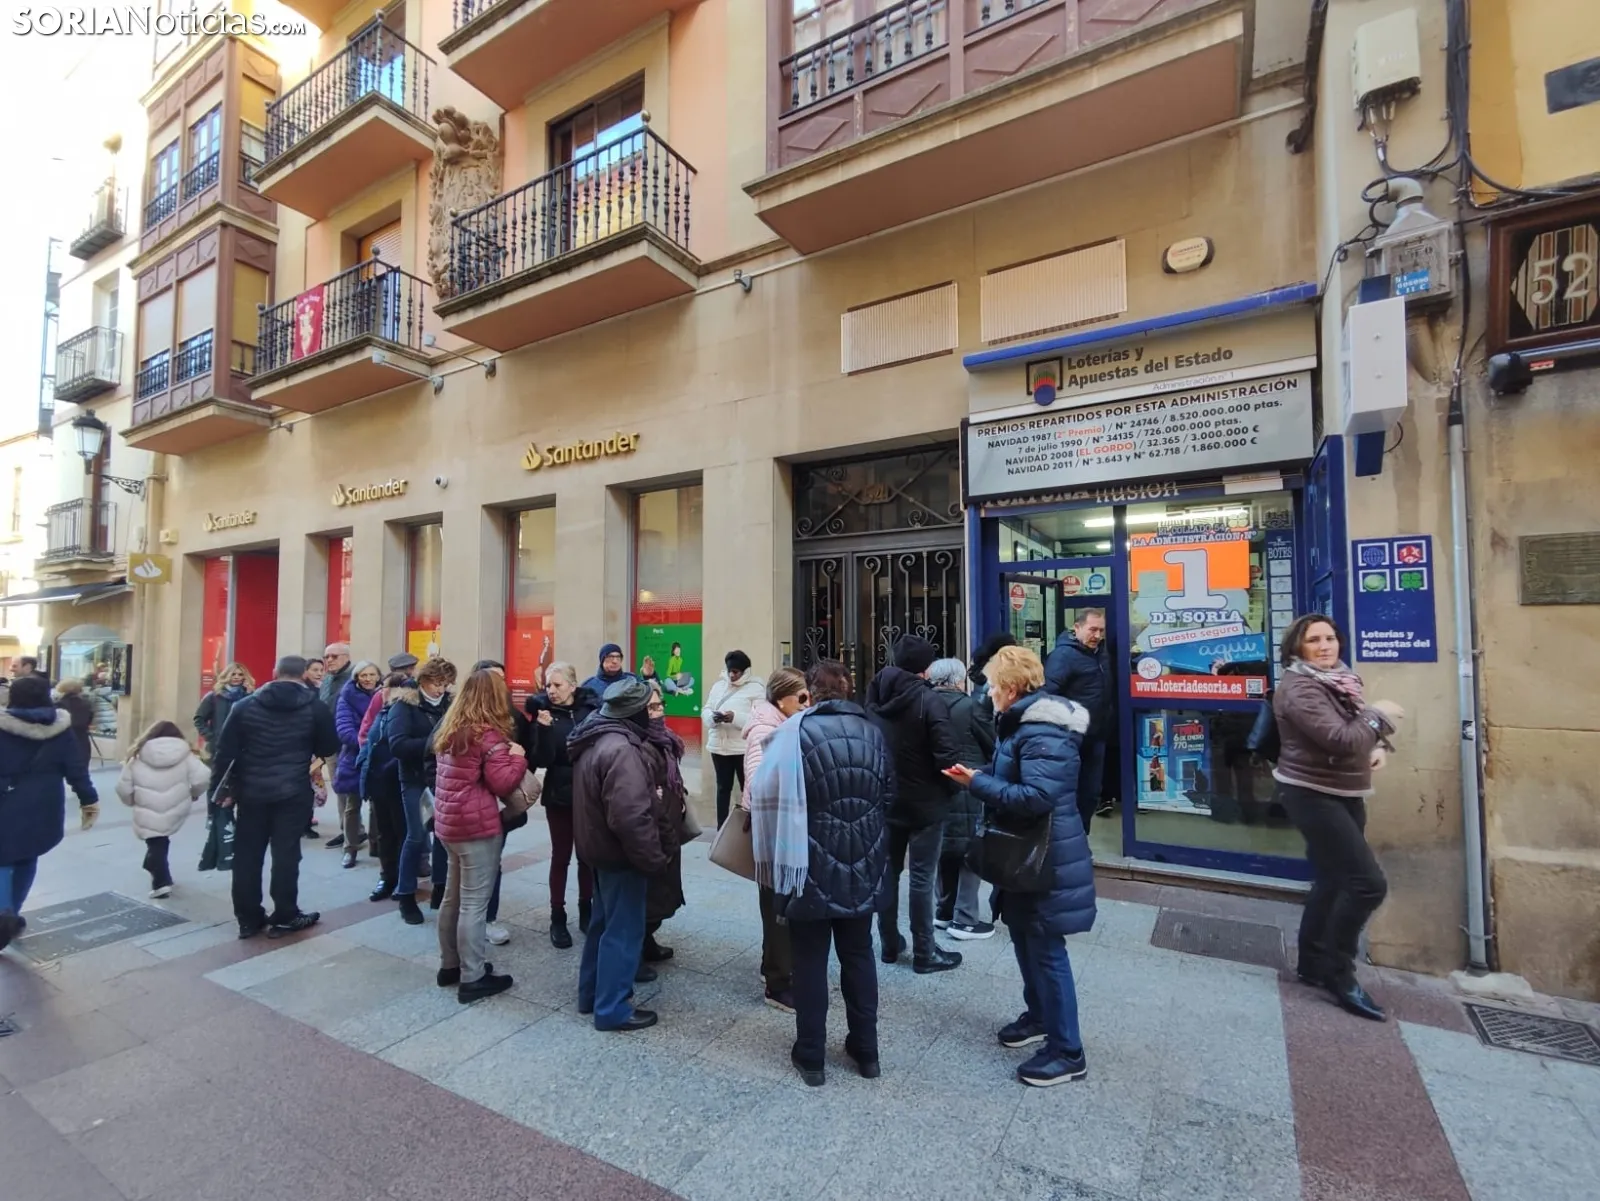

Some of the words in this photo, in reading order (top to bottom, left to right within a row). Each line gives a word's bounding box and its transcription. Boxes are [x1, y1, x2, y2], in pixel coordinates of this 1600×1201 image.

[1531, 252, 1592, 304] 52
[1067, 349, 1130, 370] Loterías
[1135, 347, 1144, 361] y
[1068, 366, 1138, 388] Apuestas
[1144, 357, 1168, 374] del
[1175, 347, 1233, 368] Estado
[977, 422, 1025, 437] PREMIOS
[1029, 410, 1102, 429] REPARTIDOS
[1105, 406, 1131, 419] POR
[1135, 400, 1166, 414] ESTA
[1170, 378, 1298, 408] ADMINISTRACIÓN
[988, 436, 1029, 449] NAVIDAD
[1032, 433, 1051, 443] 1987
[1068, 425, 1105, 438] Premio)
[1130, 416, 1159, 428] 24746
[1170, 403, 1251, 422] 8.520.000.000
[1254, 399, 1283, 412] ptas.
[1025, 445, 1036, 454] de
[1037, 443, 1058, 454] julio
[1060, 438, 1082, 449] 1990
[1106, 432, 1134, 443] 34135
[1144, 420, 1211, 437] 726.000.000
[1214, 417, 1242, 429] ptas.
[543, 431, 640, 467] Santander
[1005, 453, 1048, 466] NAVIDAD
[1050, 450, 1074, 460] 2008
[1094, 441, 1136, 455] GORDO)
[1147, 435, 1180, 447] 32.365
[1191, 425, 1249, 442] 3.000.000
[1007, 463, 1050, 476] NAVIDAD
[1052, 460, 1073, 470] 2011
[1096, 453, 1123, 464] 3.643
[1125, 454, 1131, 462] y
[1148, 446, 1181, 458] 62.718
[1192, 437, 1247, 453] 1.860.000
[346, 478, 407, 504] Santander
[212, 510, 256, 530] Santander
[1171, 523, 1211, 535] COLLADO
[1133, 537, 1148, 546] LA
[1149, 531, 1239, 546] ADMINISTRACIÓN
[1268, 547, 1292, 559] BOTES
[1164, 548, 1227, 610] 1
[1150, 612, 1177, 624] DE
[1182, 610, 1242, 624] SORIA
[1153, 633, 1197, 645] apuesta
[1200, 625, 1239, 638] segura
[1361, 630, 1404, 639] Loterías
[1406, 631, 1414, 640] y
[1362, 640, 1412, 649] Apuestas
[1413, 639, 1431, 648] del
[1362, 649, 1399, 658] Estado
[1135, 679, 1242, 694] www.loteriadesoria.es
